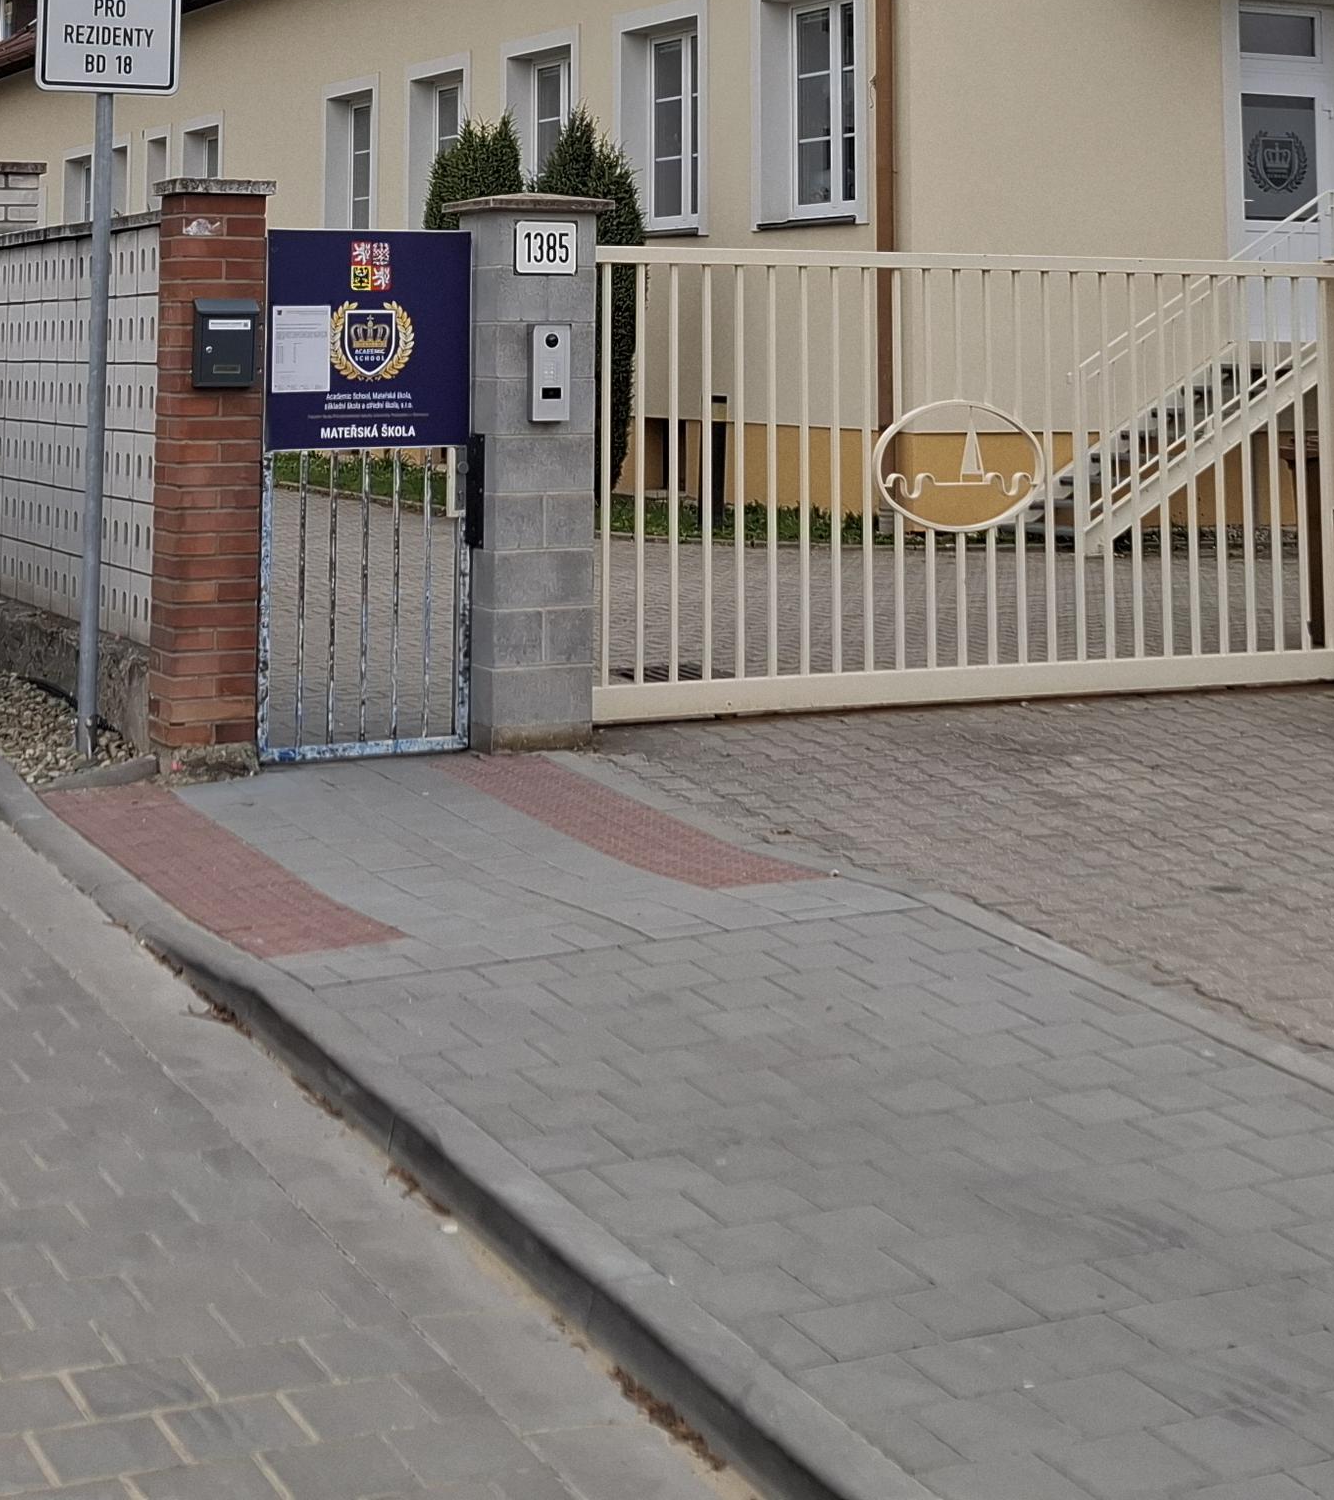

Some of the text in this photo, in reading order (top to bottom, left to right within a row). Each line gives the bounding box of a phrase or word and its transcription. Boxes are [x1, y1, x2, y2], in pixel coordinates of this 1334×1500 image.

[64, 24, 155, 49] REZIDENTY
[85, 54, 133, 76] BD 18
[524, 231, 570, 264] 1385
[320, 423, 416, 439] MATEŘSKÁ ŠKOLA
